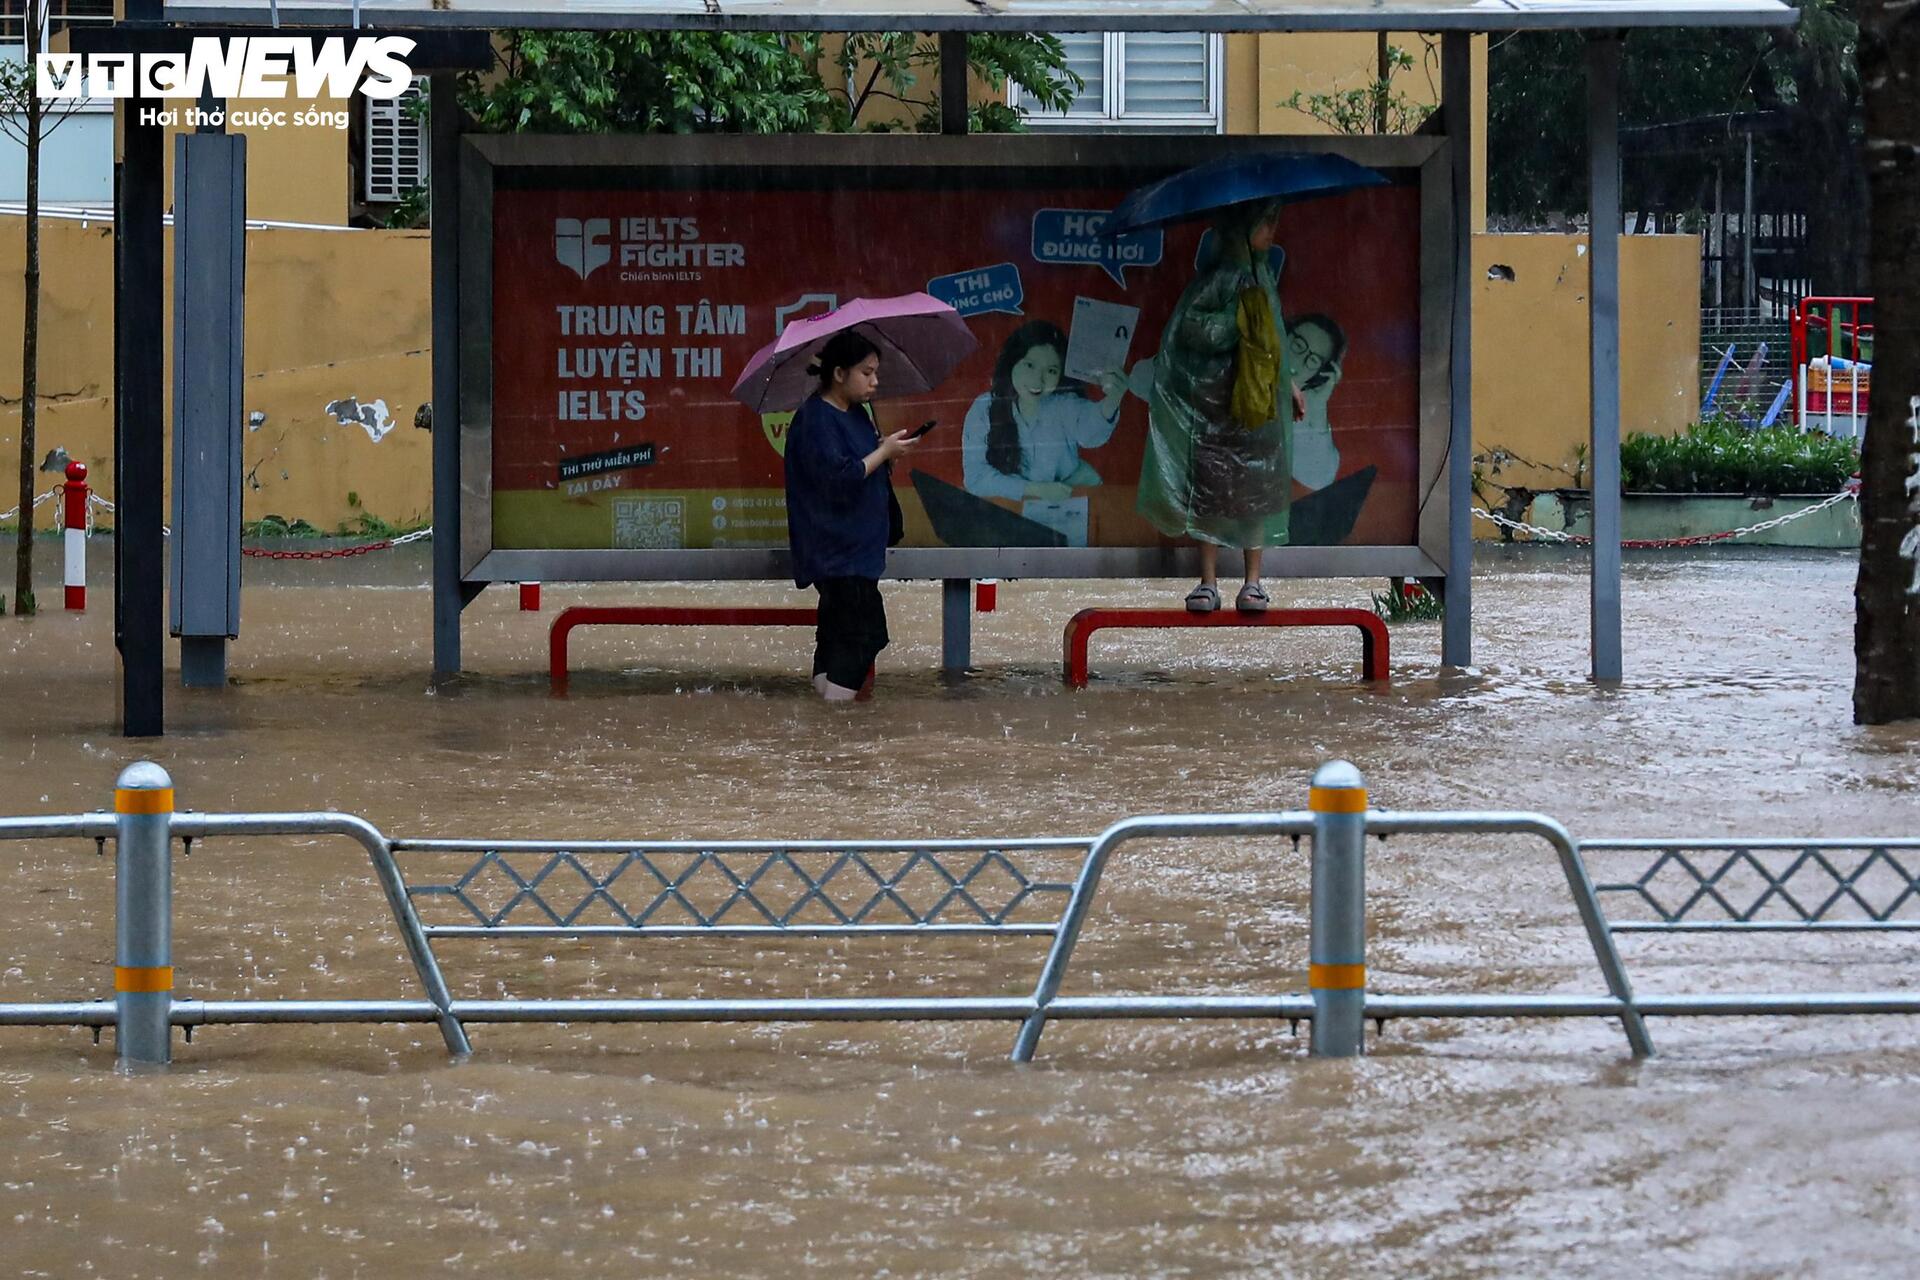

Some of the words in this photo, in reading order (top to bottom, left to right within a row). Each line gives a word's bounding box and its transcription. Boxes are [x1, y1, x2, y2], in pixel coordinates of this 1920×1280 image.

[619, 217, 700, 241] IELTS
[619, 243, 746, 267] FIGHTER
[1042, 238, 1102, 258] ĐÚNG
[676, 271, 702, 281] IELTS
[954, 272, 991, 293] THI
[948, 294, 980, 309] ÚNG
[556, 304, 666, 336] TRUNG
[675, 298, 746, 335] TÂM
[557, 341, 661, 386] LUYỆN
[671, 347, 722, 378] THI
[558, 389, 647, 421] IELTS
[562, 463, 579, 476] THI
[633, 447, 652, 462] PHÍ
